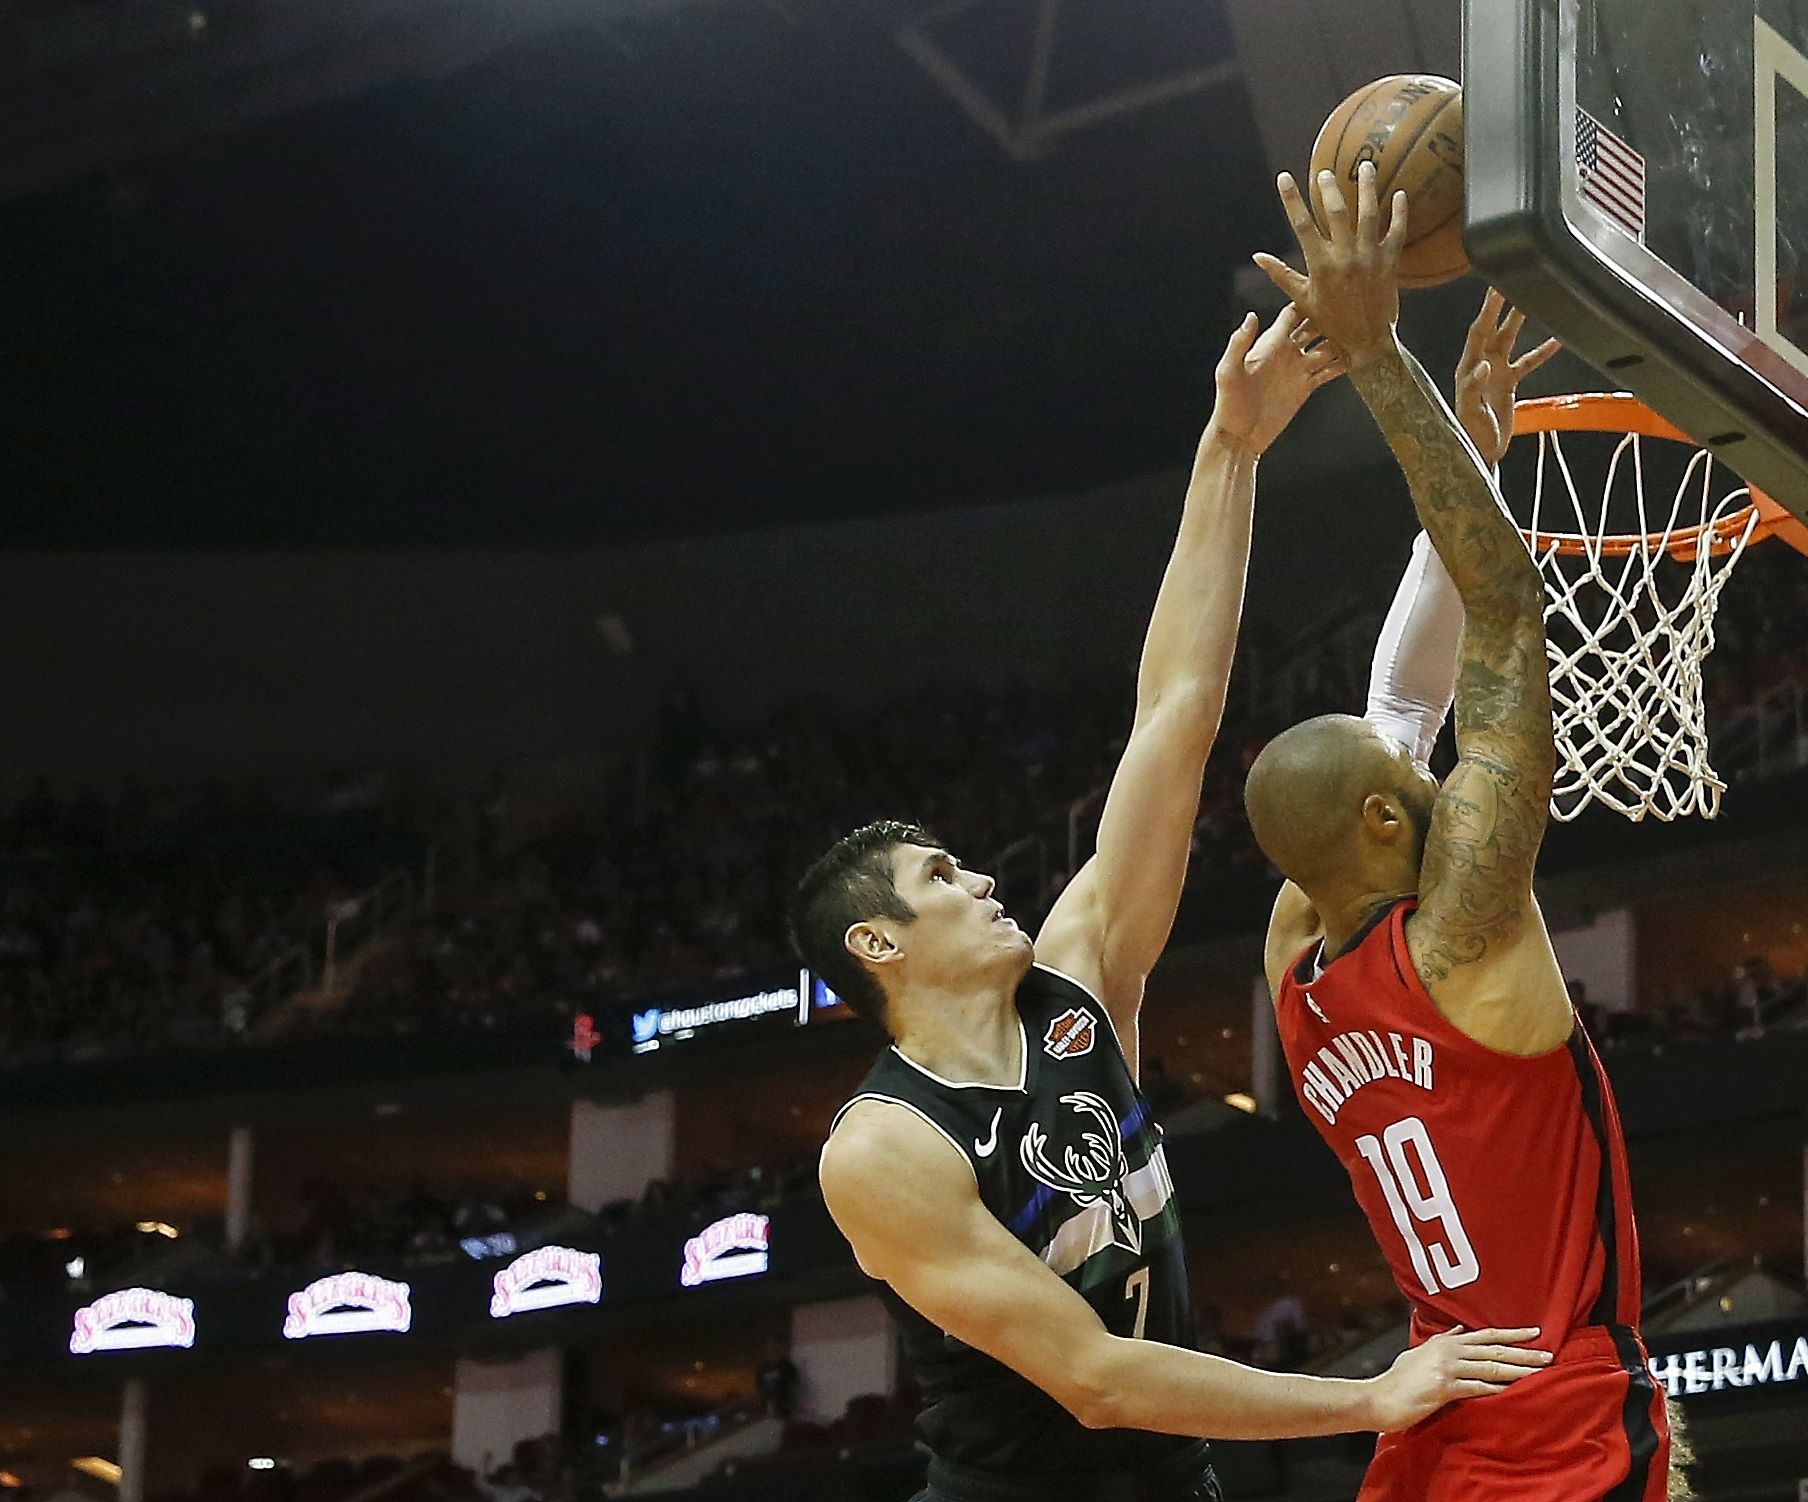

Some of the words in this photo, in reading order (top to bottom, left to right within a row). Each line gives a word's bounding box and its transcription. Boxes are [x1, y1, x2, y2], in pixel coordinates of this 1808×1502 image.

[1302, 1030, 1434, 1125] CHANDLER
[1354, 1116, 1481, 1297] 19
[1125, 1266, 1150, 1340] 7
